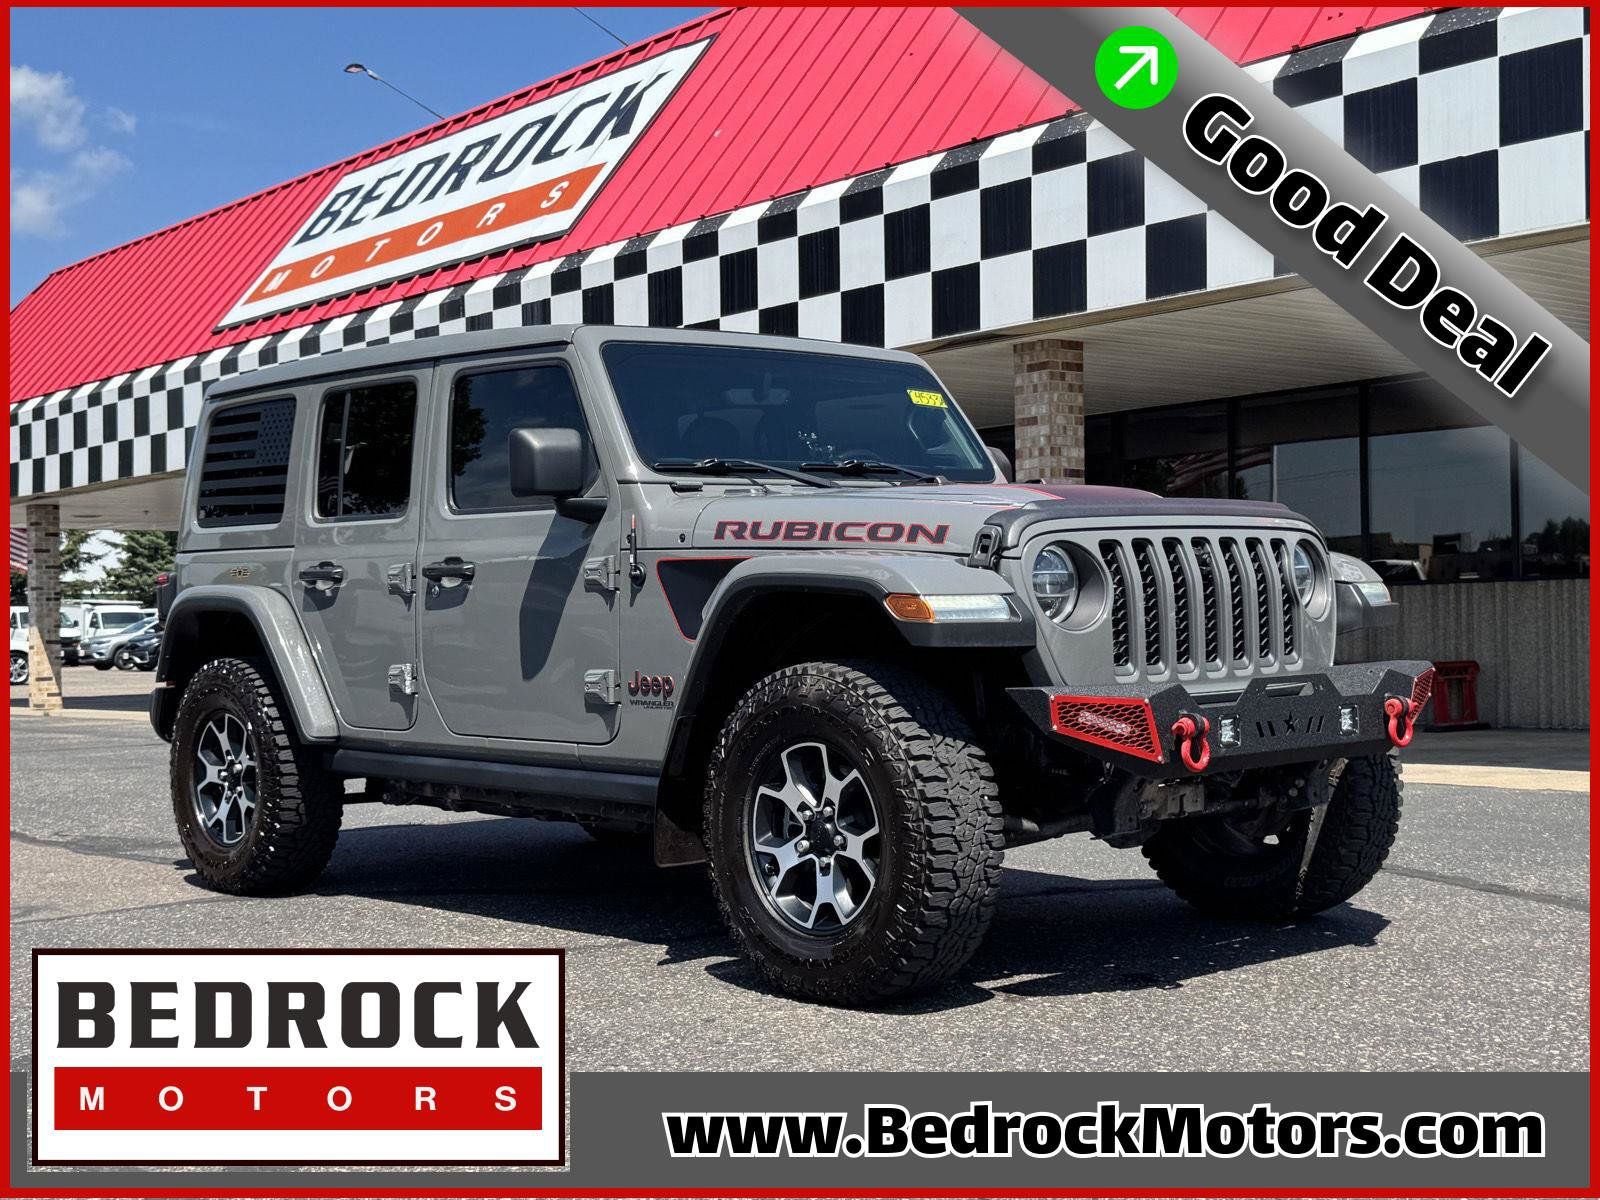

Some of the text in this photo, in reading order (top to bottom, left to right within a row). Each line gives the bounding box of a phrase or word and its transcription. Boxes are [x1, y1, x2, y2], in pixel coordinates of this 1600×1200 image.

[294, 71, 672, 246] BEDROCK
[264, 181, 569, 292] MOTORS
[713, 520, 950, 544] RUBICON
[628, 670, 674, 700] Jeep
